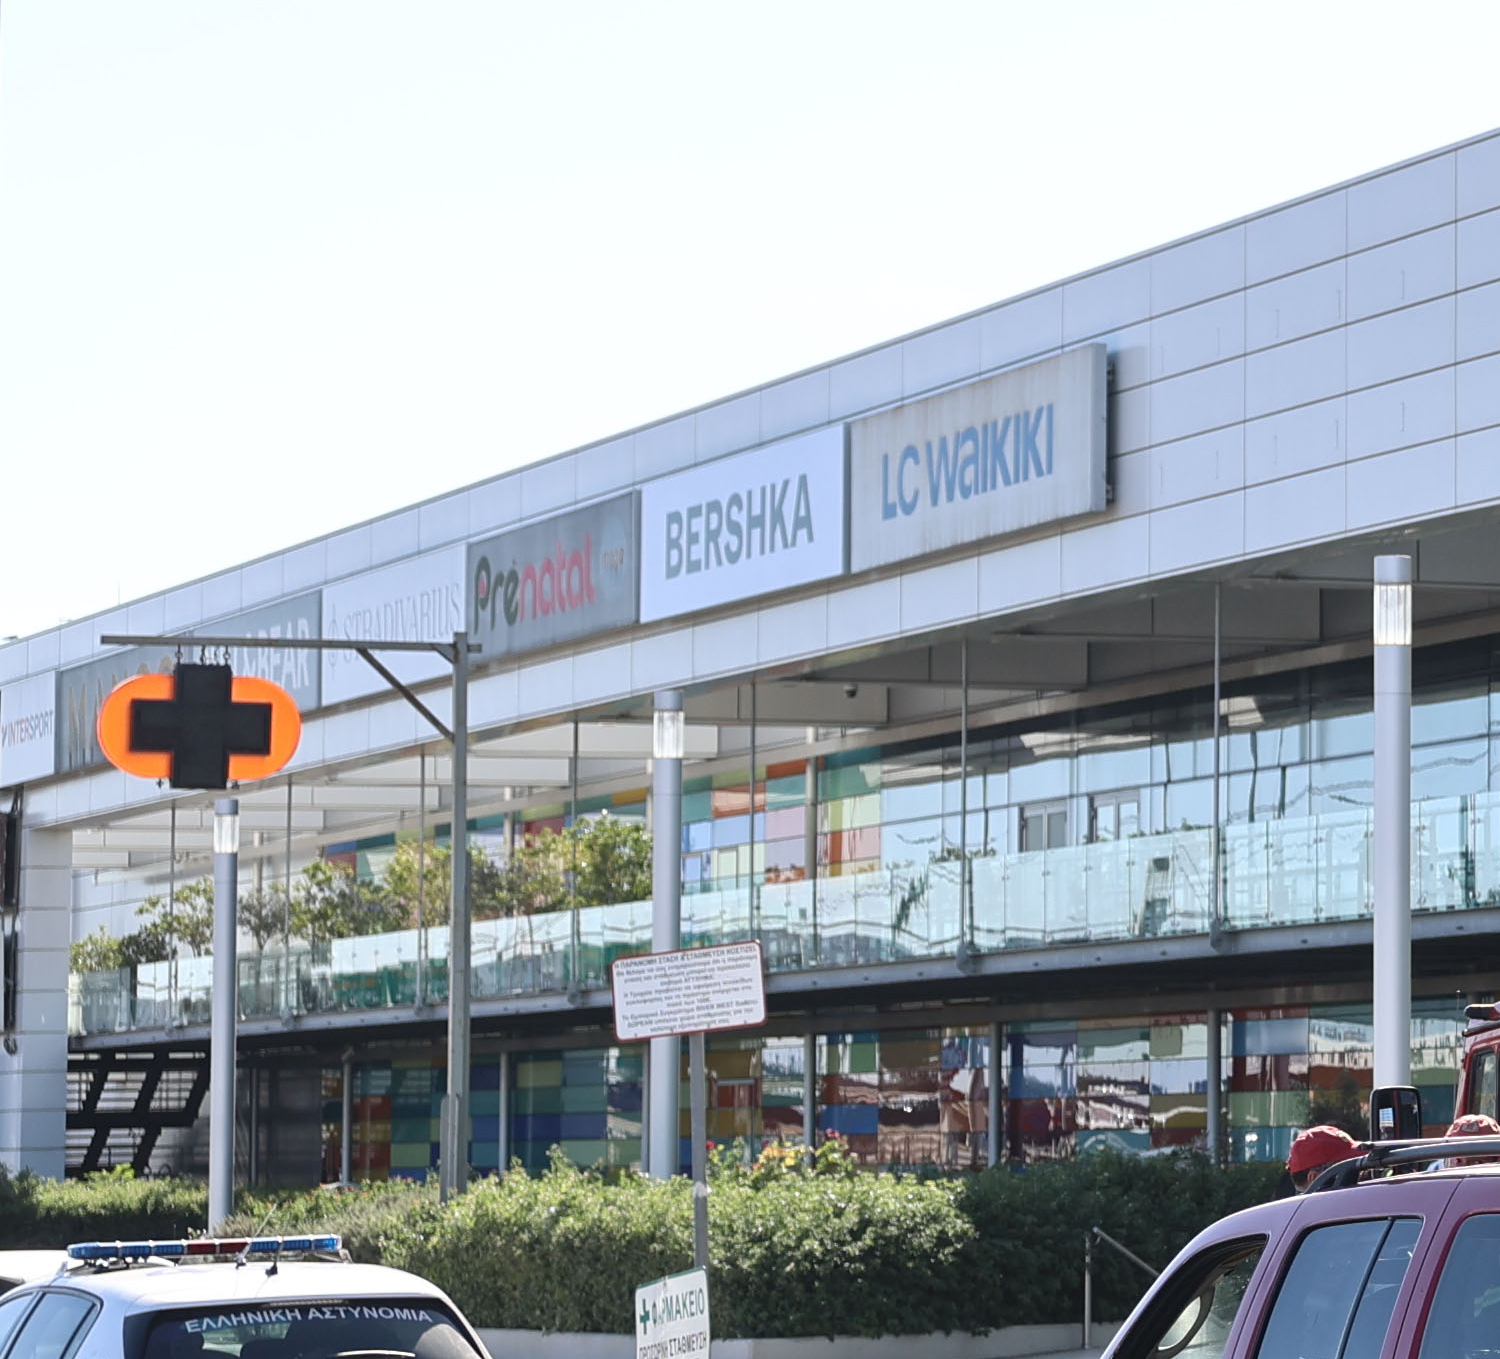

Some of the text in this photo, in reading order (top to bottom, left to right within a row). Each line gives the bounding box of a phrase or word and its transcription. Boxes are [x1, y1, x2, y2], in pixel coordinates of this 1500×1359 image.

[881, 444, 920, 522] LC
[665, 473, 815, 581] BERSHKA
[8, 710, 54, 747] INTERSPORT
[185, 1306, 433, 1334] ΕΛΛΗΝΙΚΗ ΑΣΤΥΝΟΜΙΑ
[651, 1288, 705, 1326] ΦΑΡΜΑΚΕΙΟ
